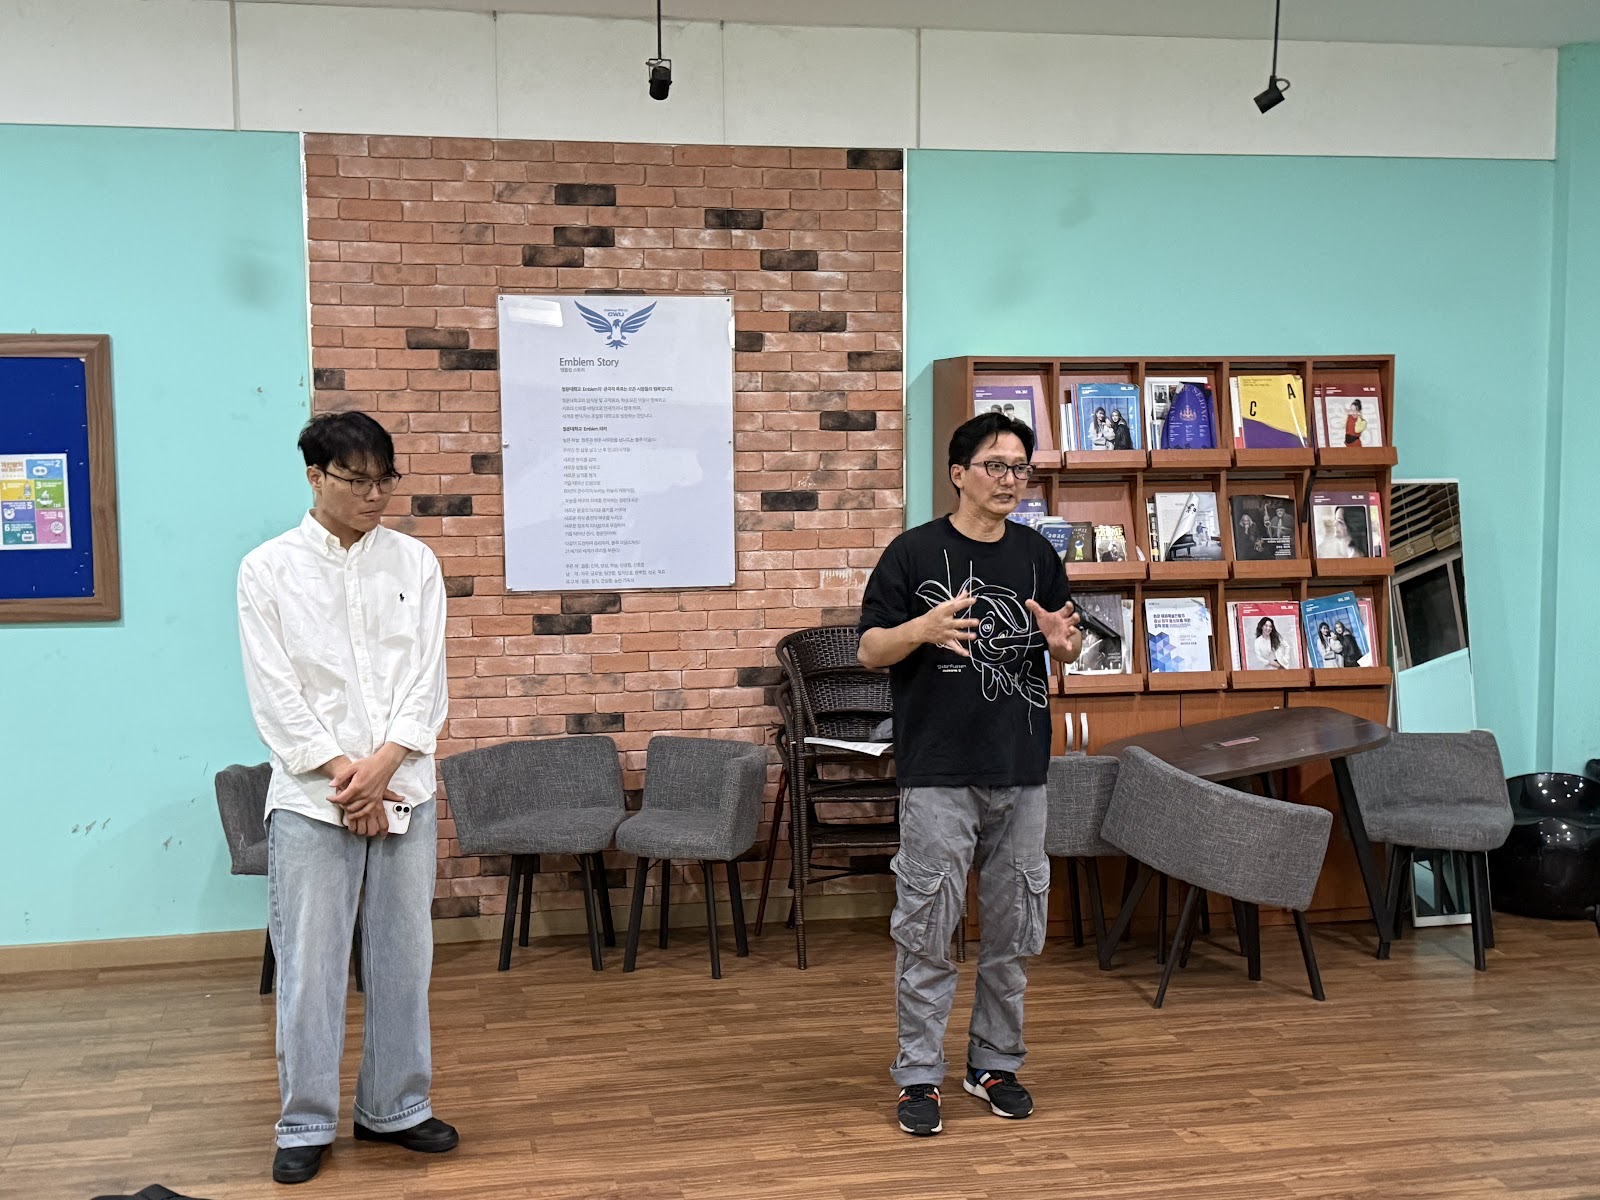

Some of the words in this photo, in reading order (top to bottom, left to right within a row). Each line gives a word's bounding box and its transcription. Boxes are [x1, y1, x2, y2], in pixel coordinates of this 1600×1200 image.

[560, 357, 594, 366] Emblem
[597, 358, 619, 367] Story
[1287, 383, 1296, 399] A
[1250, 400, 1257, 416] C
